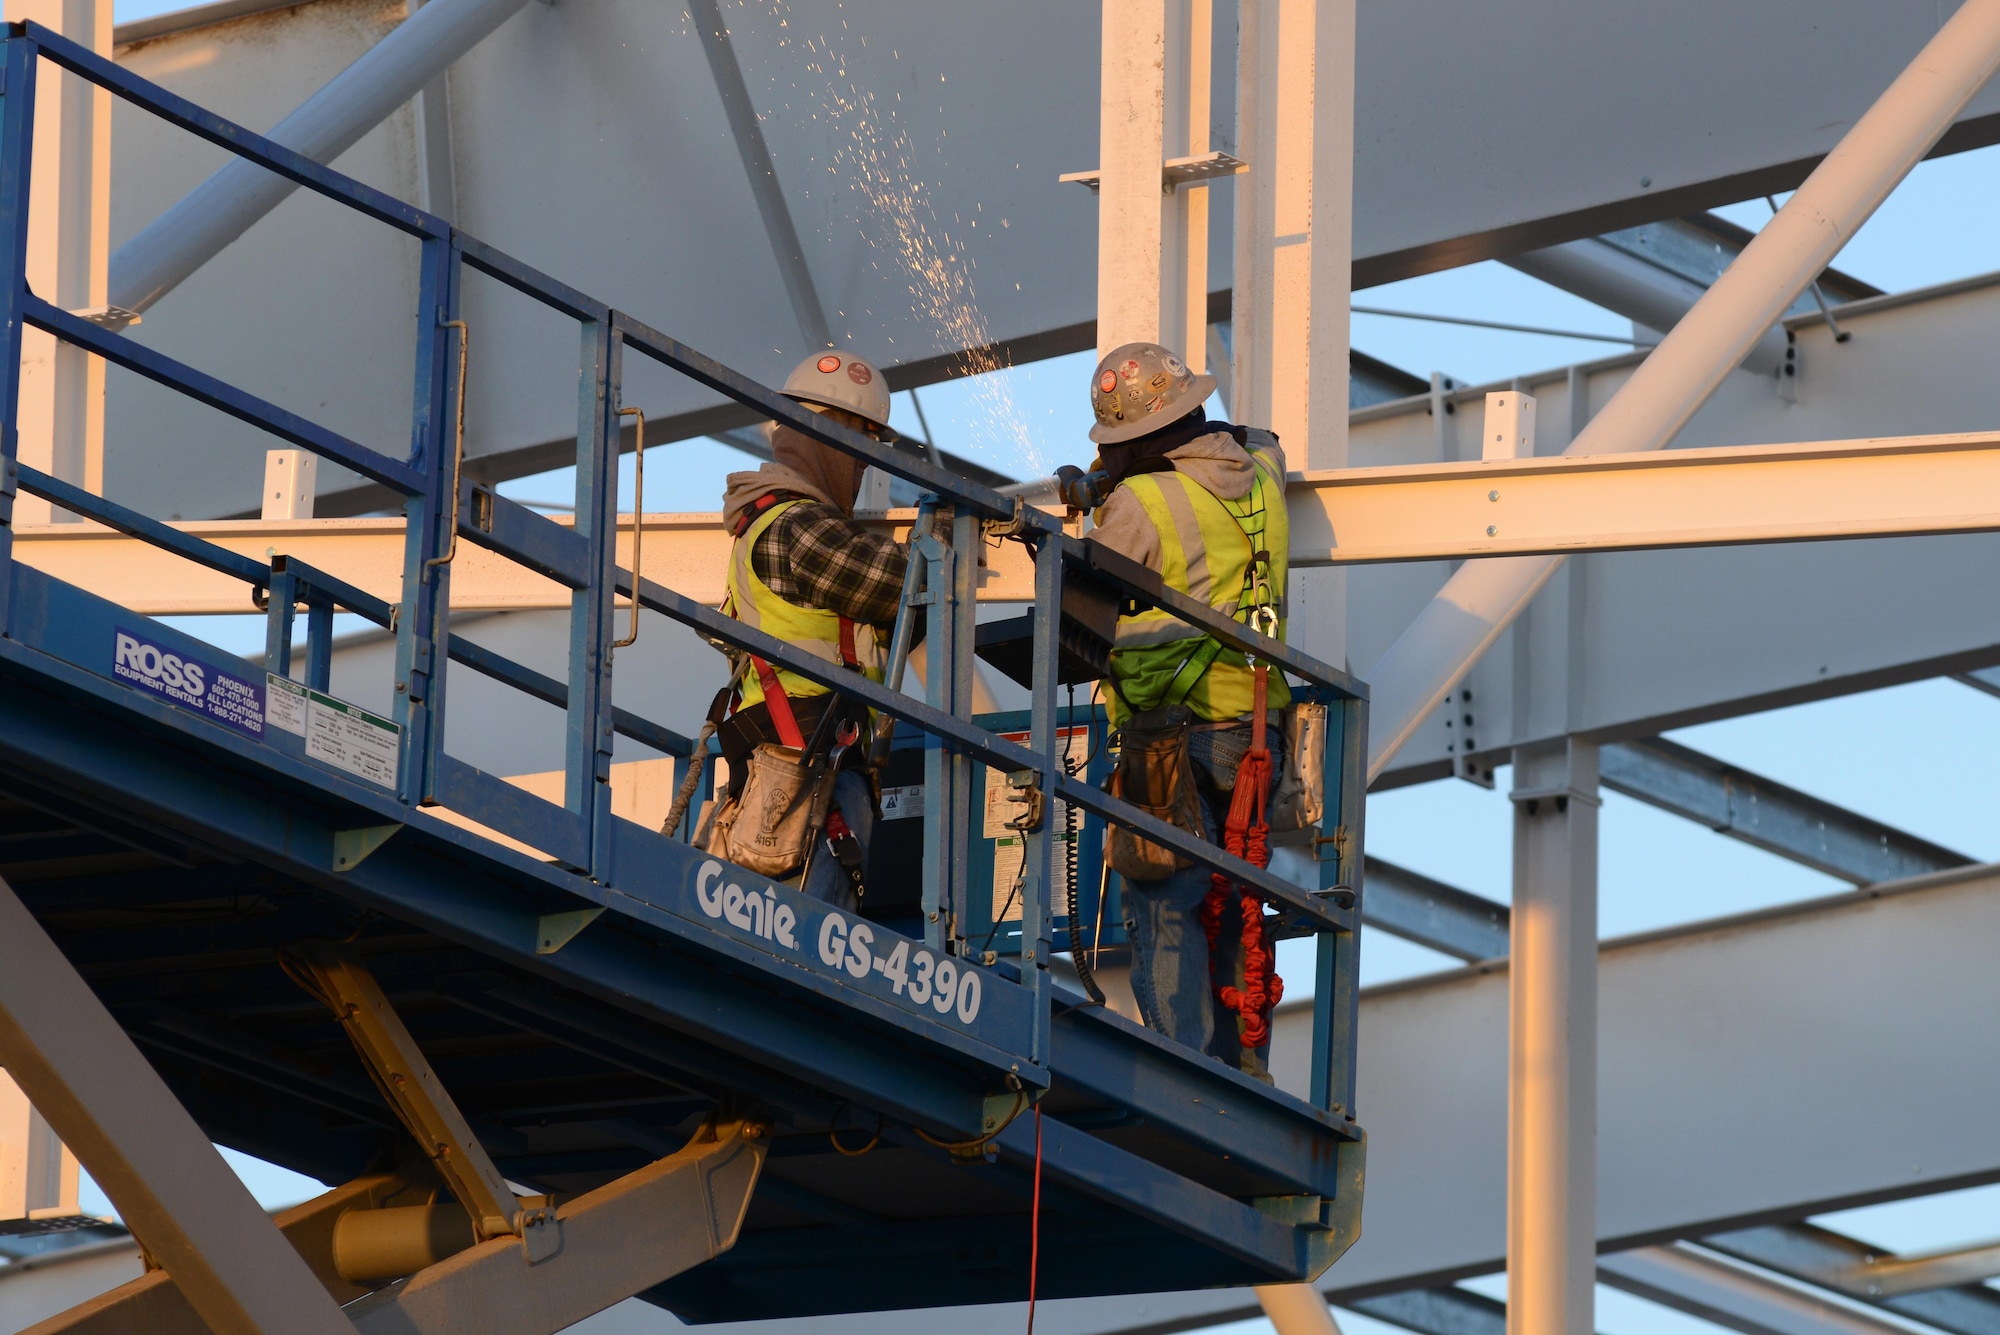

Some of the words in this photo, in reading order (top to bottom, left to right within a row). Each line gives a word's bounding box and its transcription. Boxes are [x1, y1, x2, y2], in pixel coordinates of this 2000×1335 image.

[115, 632, 205, 697] ROSS
[114, 663, 164, 692] EQUIPMENT
[165, 685, 204, 709] RENTALS
[211, 683, 260, 711] 602-470-1000
[217, 674, 255, 700] PHOENIX
[206, 692, 221, 706] ALL
[222, 698, 264, 724] LOCATIONS
[207, 703, 262, 733] 1-888-271-4620
[346, 705, 363, 720] NOTICE
[754, 833, 779, 848] 5416T
[696, 859, 796, 950] Genie
[818, 911, 982, 1025] GS-4390
